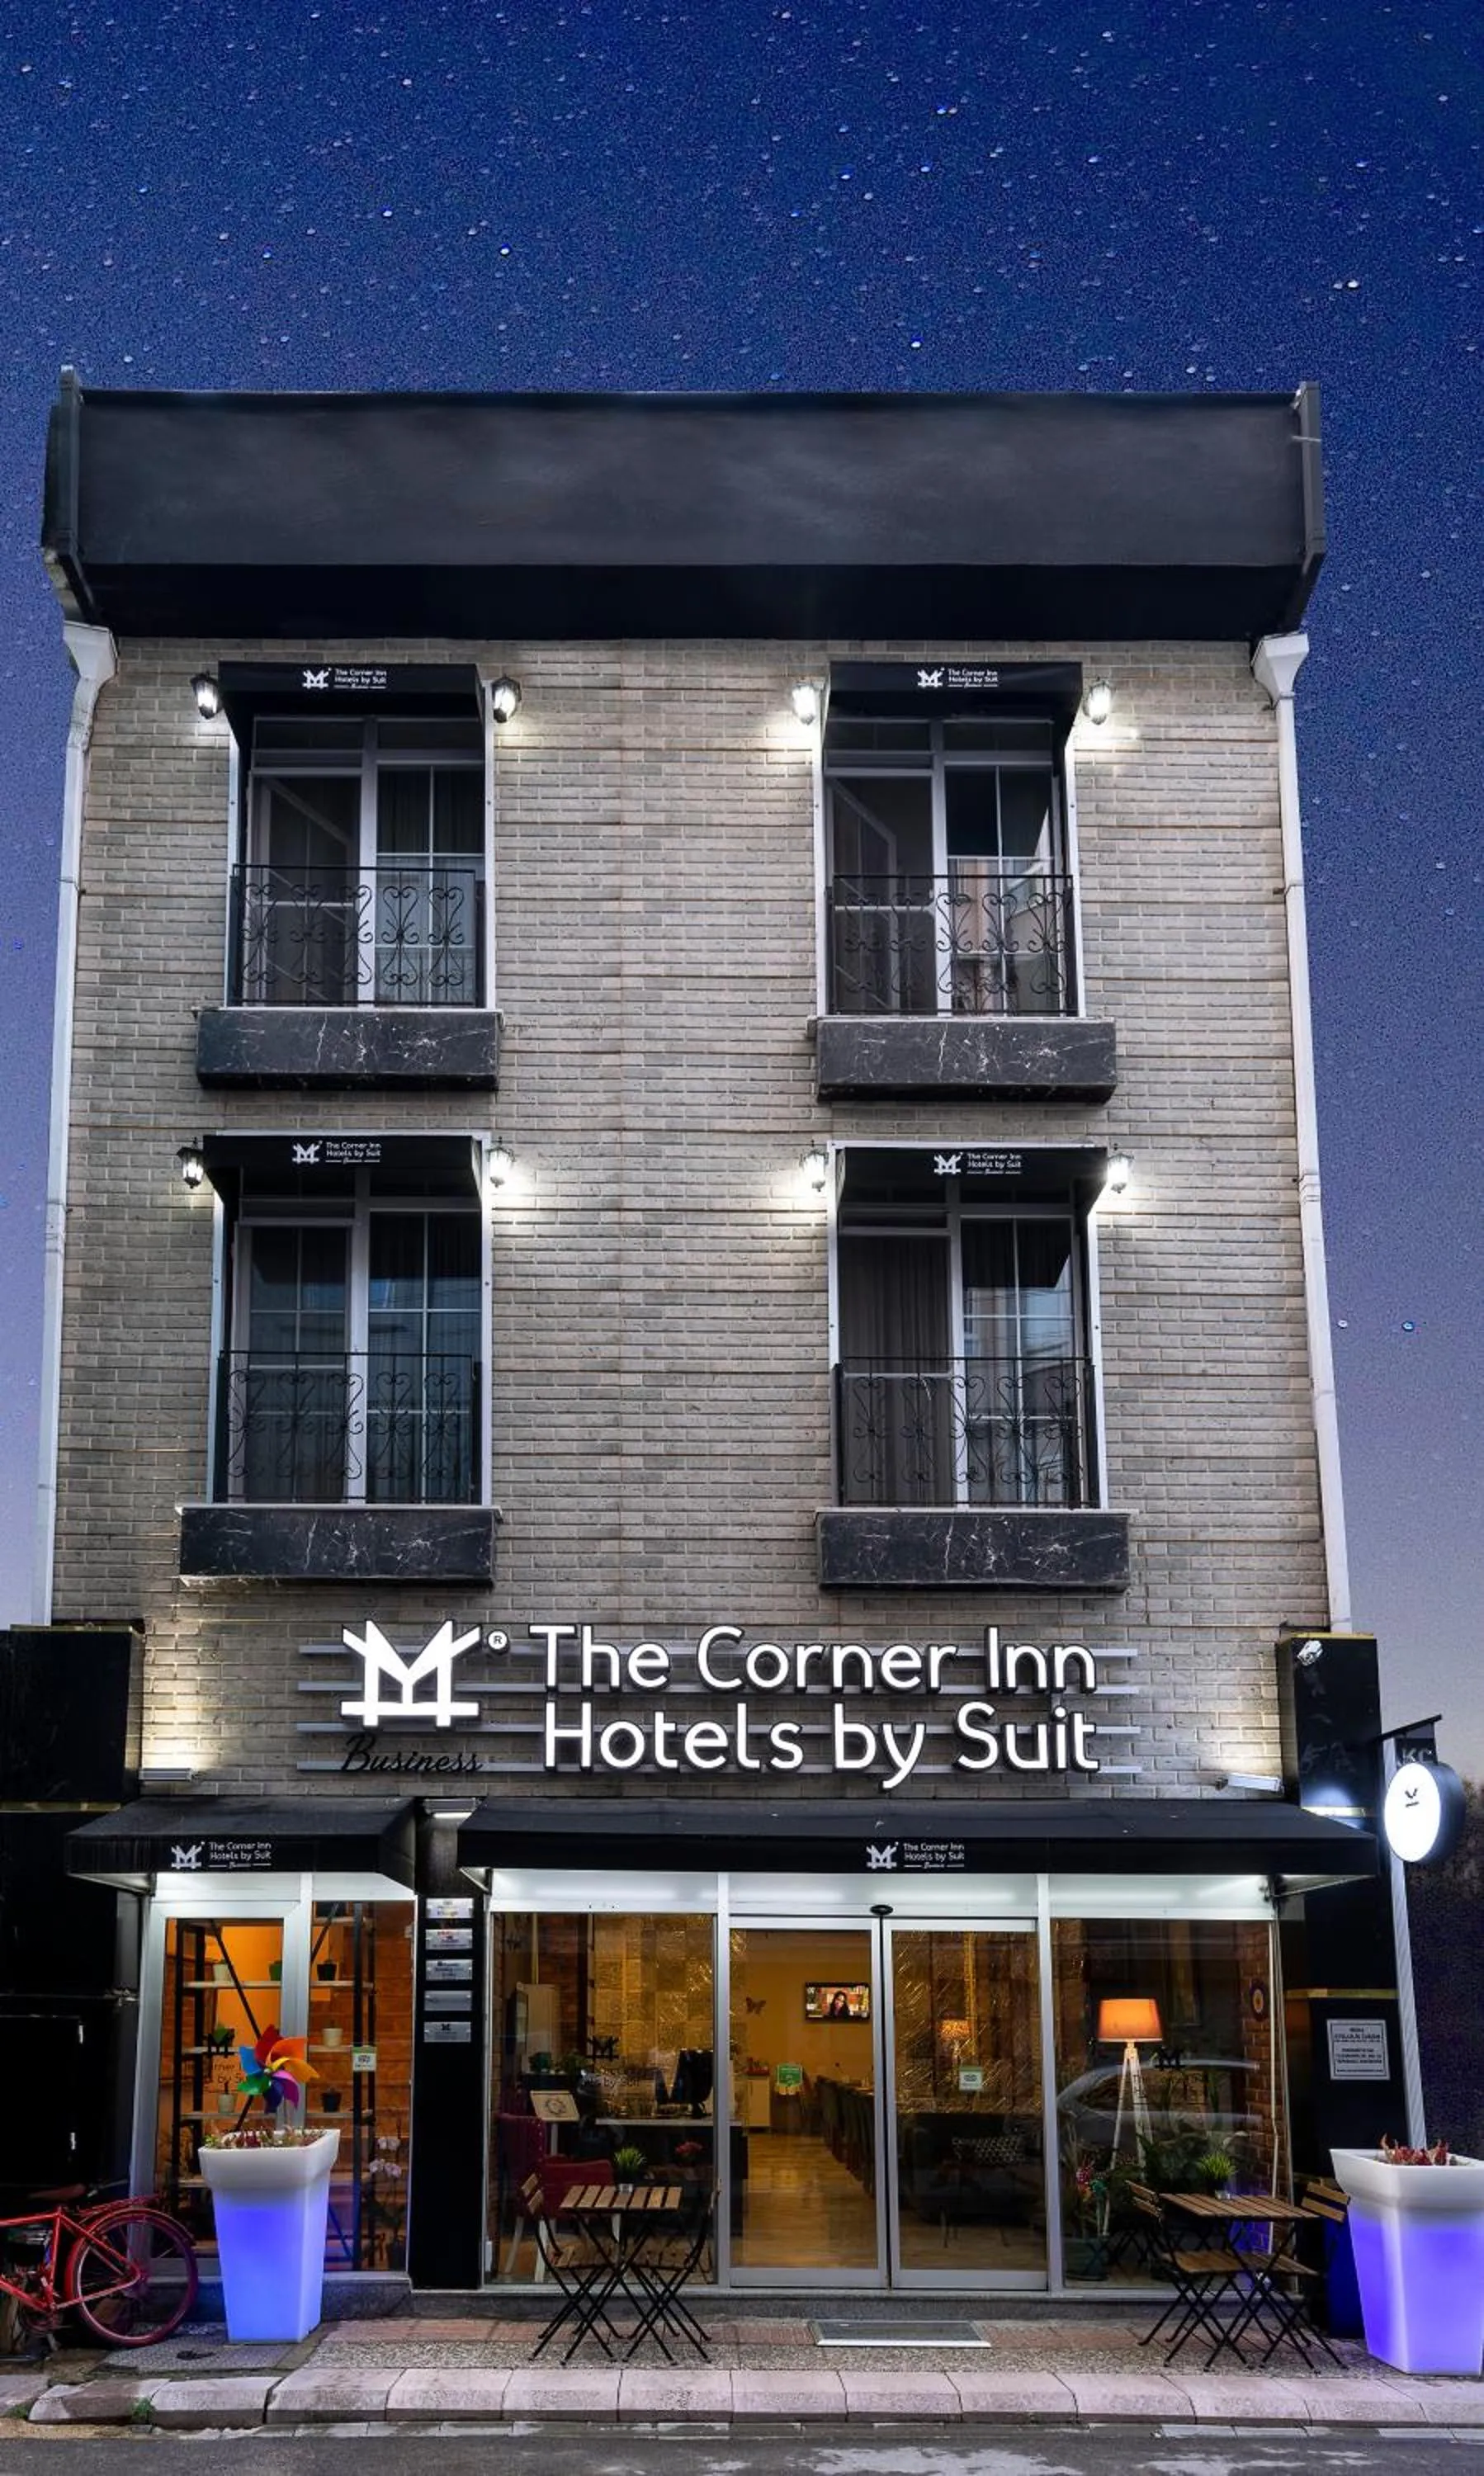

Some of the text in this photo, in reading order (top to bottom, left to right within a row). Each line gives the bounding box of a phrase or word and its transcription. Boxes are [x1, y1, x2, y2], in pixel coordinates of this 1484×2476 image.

[354, 1150, 364, 1158] by
[995, 1160, 1005, 1169] by
[528, 1623, 1098, 1693] The Corner Inn
[544, 1700, 1100, 1792] Hotels by Suit
[341, 1735, 484, 1774] Business
[209, 1841, 224, 1850] The
[226, 1841, 255, 1850] Corner
[903, 1842, 919, 1850] The
[920, 1842, 948, 1850] Corner
[240, 1851, 253, 1861] by
[934, 1852, 947, 1862] by
